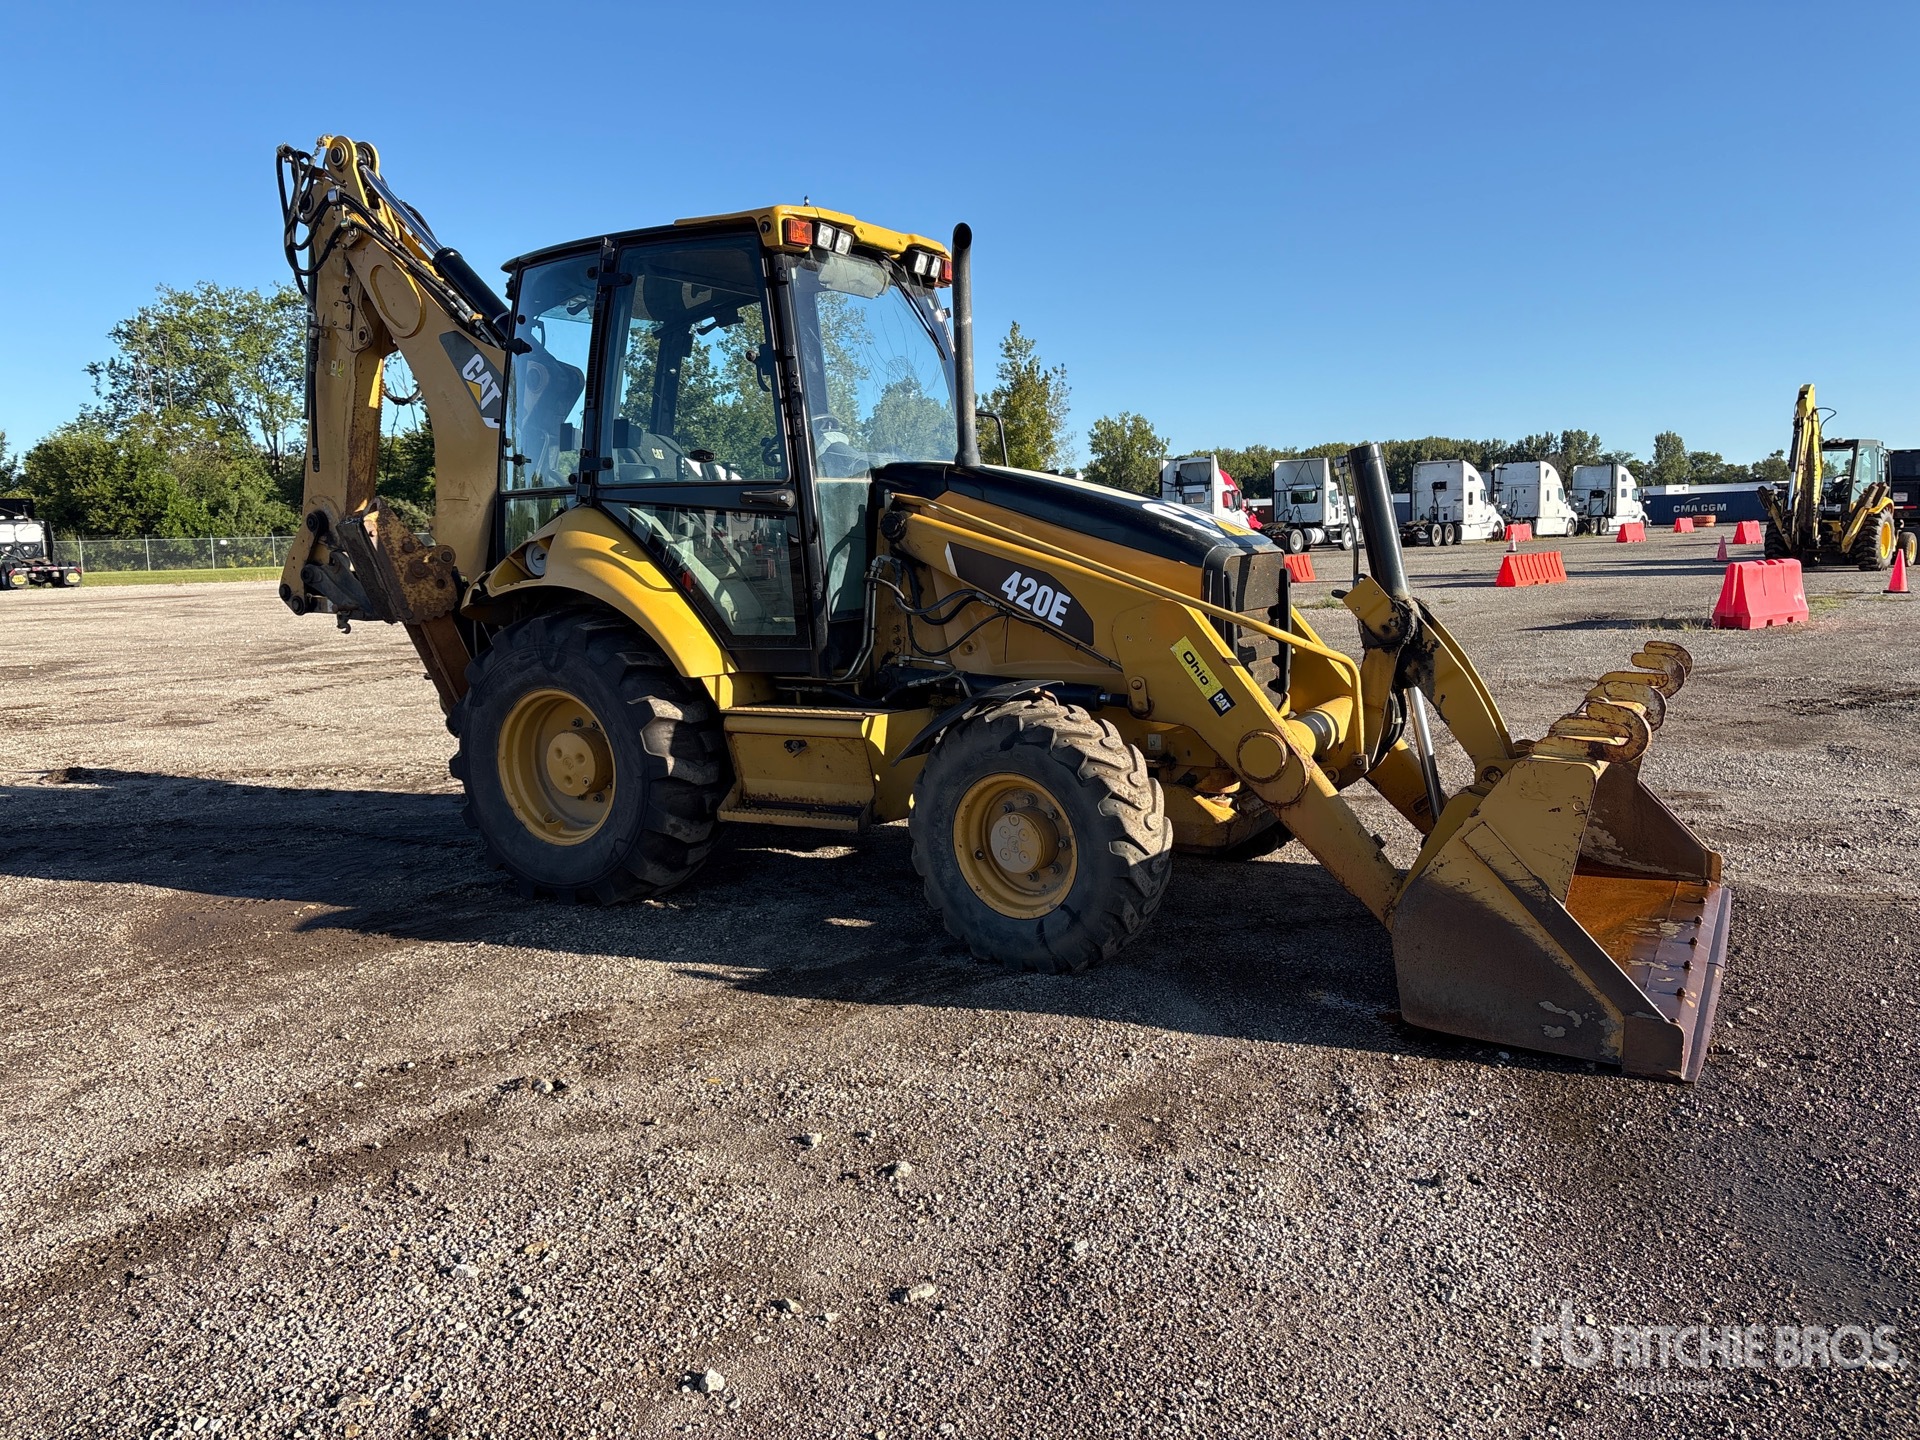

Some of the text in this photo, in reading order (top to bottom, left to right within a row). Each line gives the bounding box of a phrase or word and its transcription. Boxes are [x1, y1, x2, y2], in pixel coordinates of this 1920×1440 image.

[462, 353, 502, 410] CAT
[1673, 503, 1726, 512] CMA CGM
[1001, 570, 1071, 627] 420E
[1183, 651, 1231, 711] Ohio CAT
